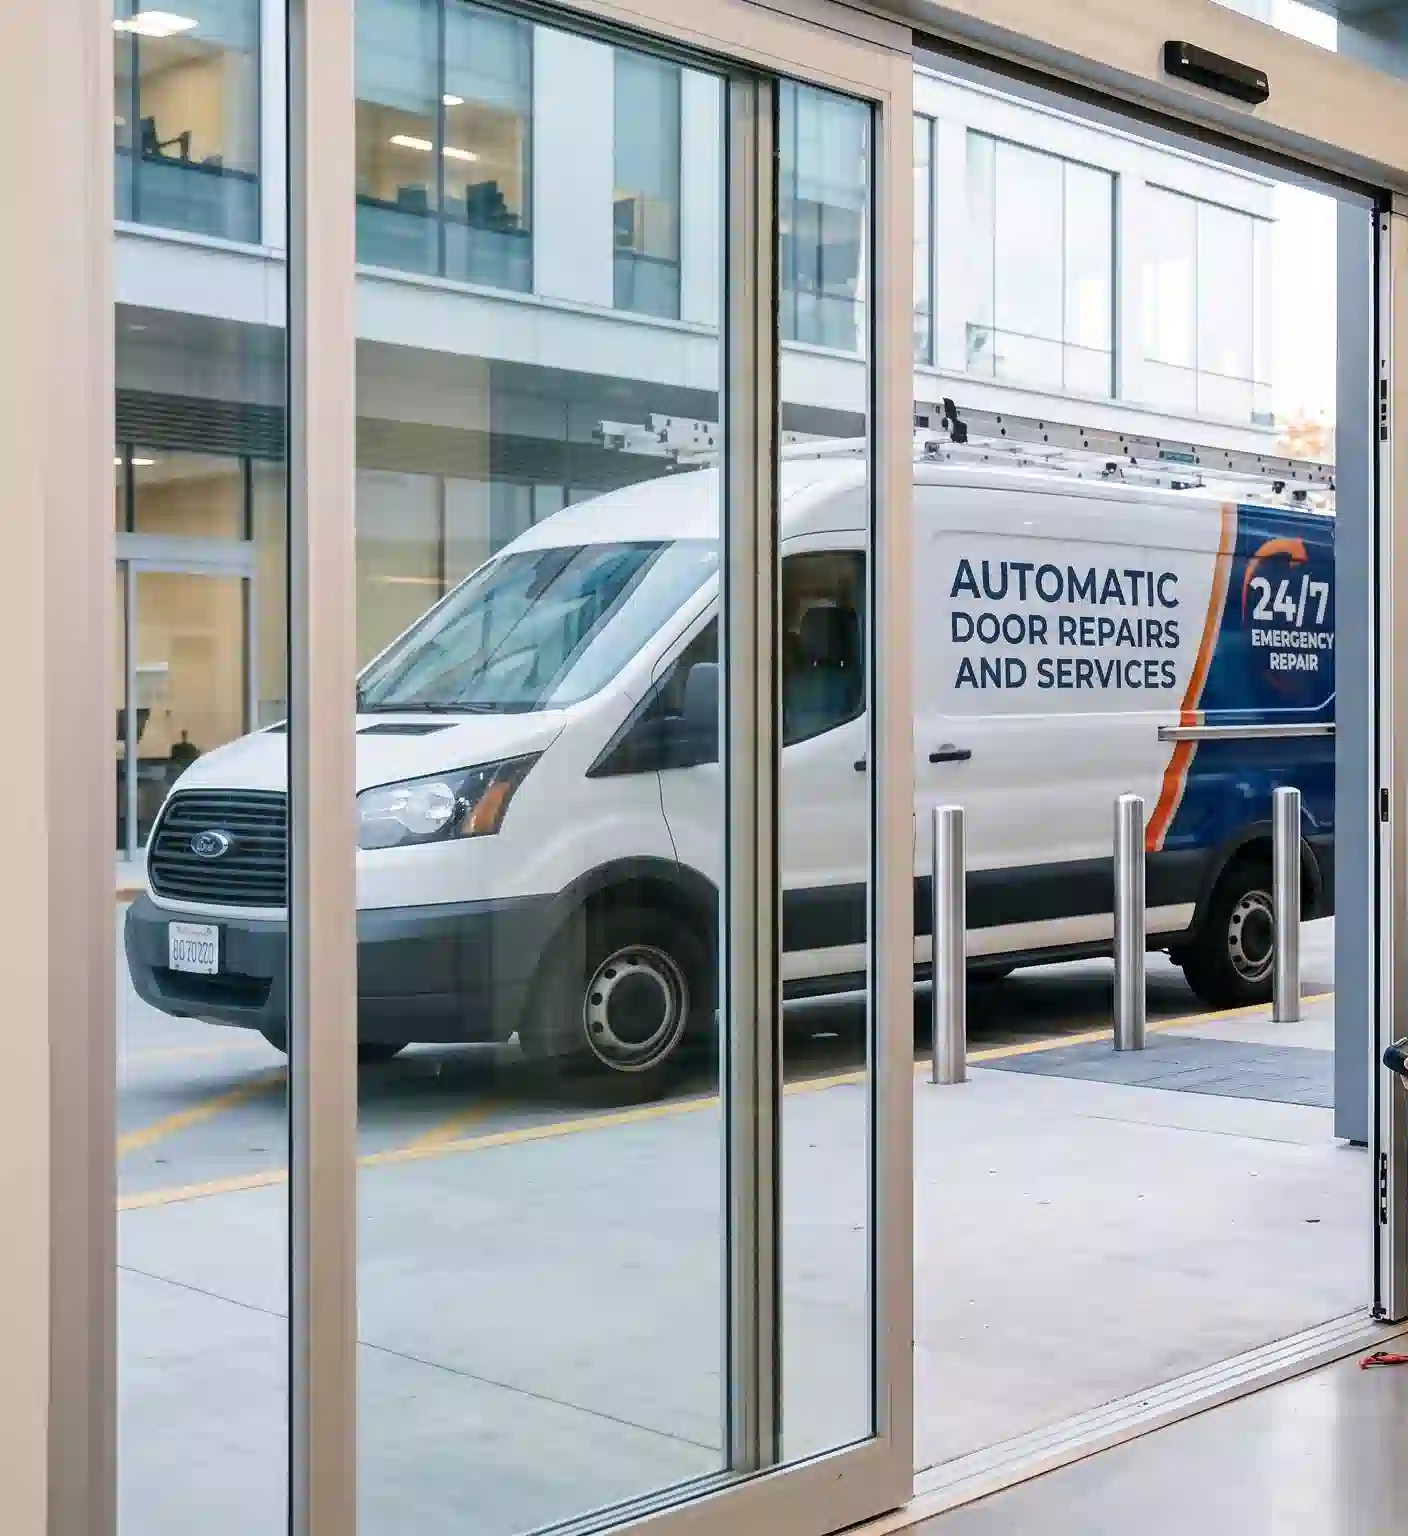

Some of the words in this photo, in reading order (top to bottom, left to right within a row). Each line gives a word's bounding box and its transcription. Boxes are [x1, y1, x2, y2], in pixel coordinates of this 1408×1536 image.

[950, 559, 1180, 608] AUTOMATIC
[1249, 574, 1329, 627] 24/7
[952, 611, 1048, 645] DOOR
[1058, 616, 1180, 649] REPAIRS
[1251, 629, 1335, 650] EMERGENCY
[954, 656, 1027, 689] AND
[1037, 658, 1177, 689] SERVICES
[1270, 652, 1319, 671] REPAIR
